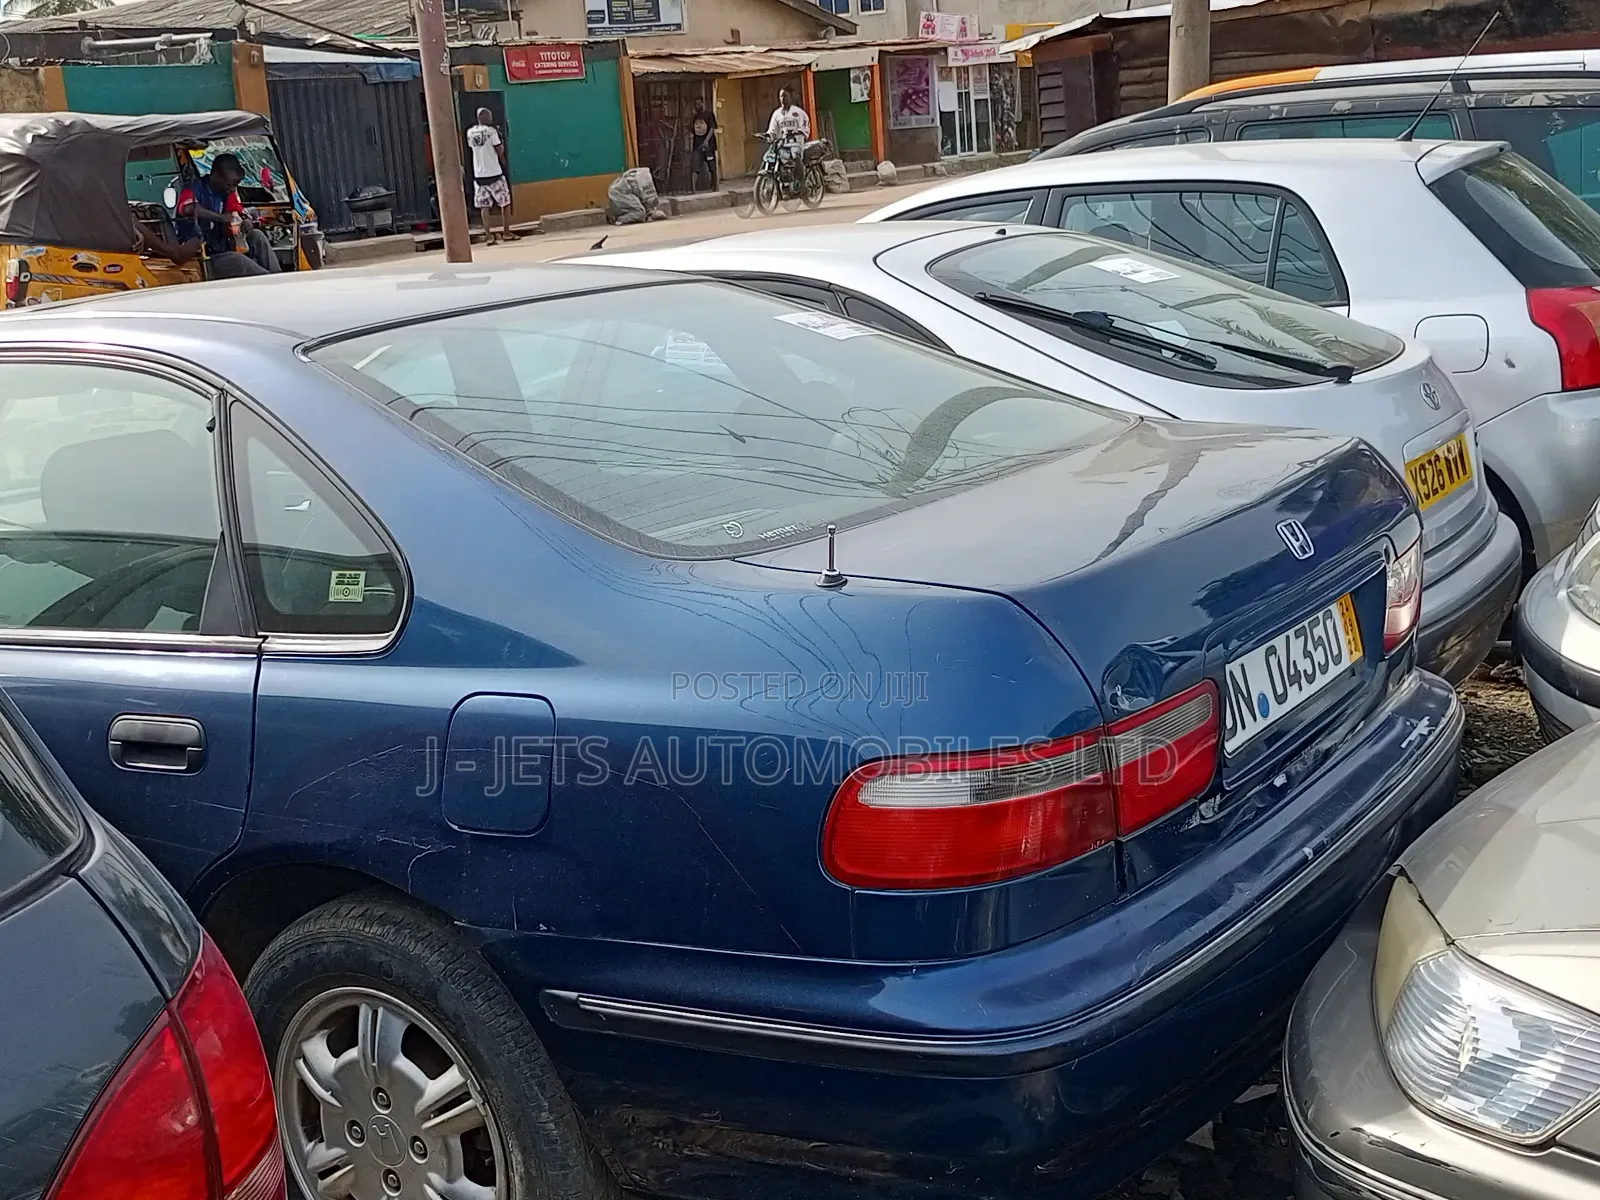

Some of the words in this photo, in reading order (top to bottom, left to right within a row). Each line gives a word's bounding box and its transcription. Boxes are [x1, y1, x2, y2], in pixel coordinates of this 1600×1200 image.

[539, 52, 571, 61] TITOTOP
[534, 61, 557, 69] CATERING
[558, 60, 579, 68] SERVICES
[1265, 609, 1342, 705] 04350
